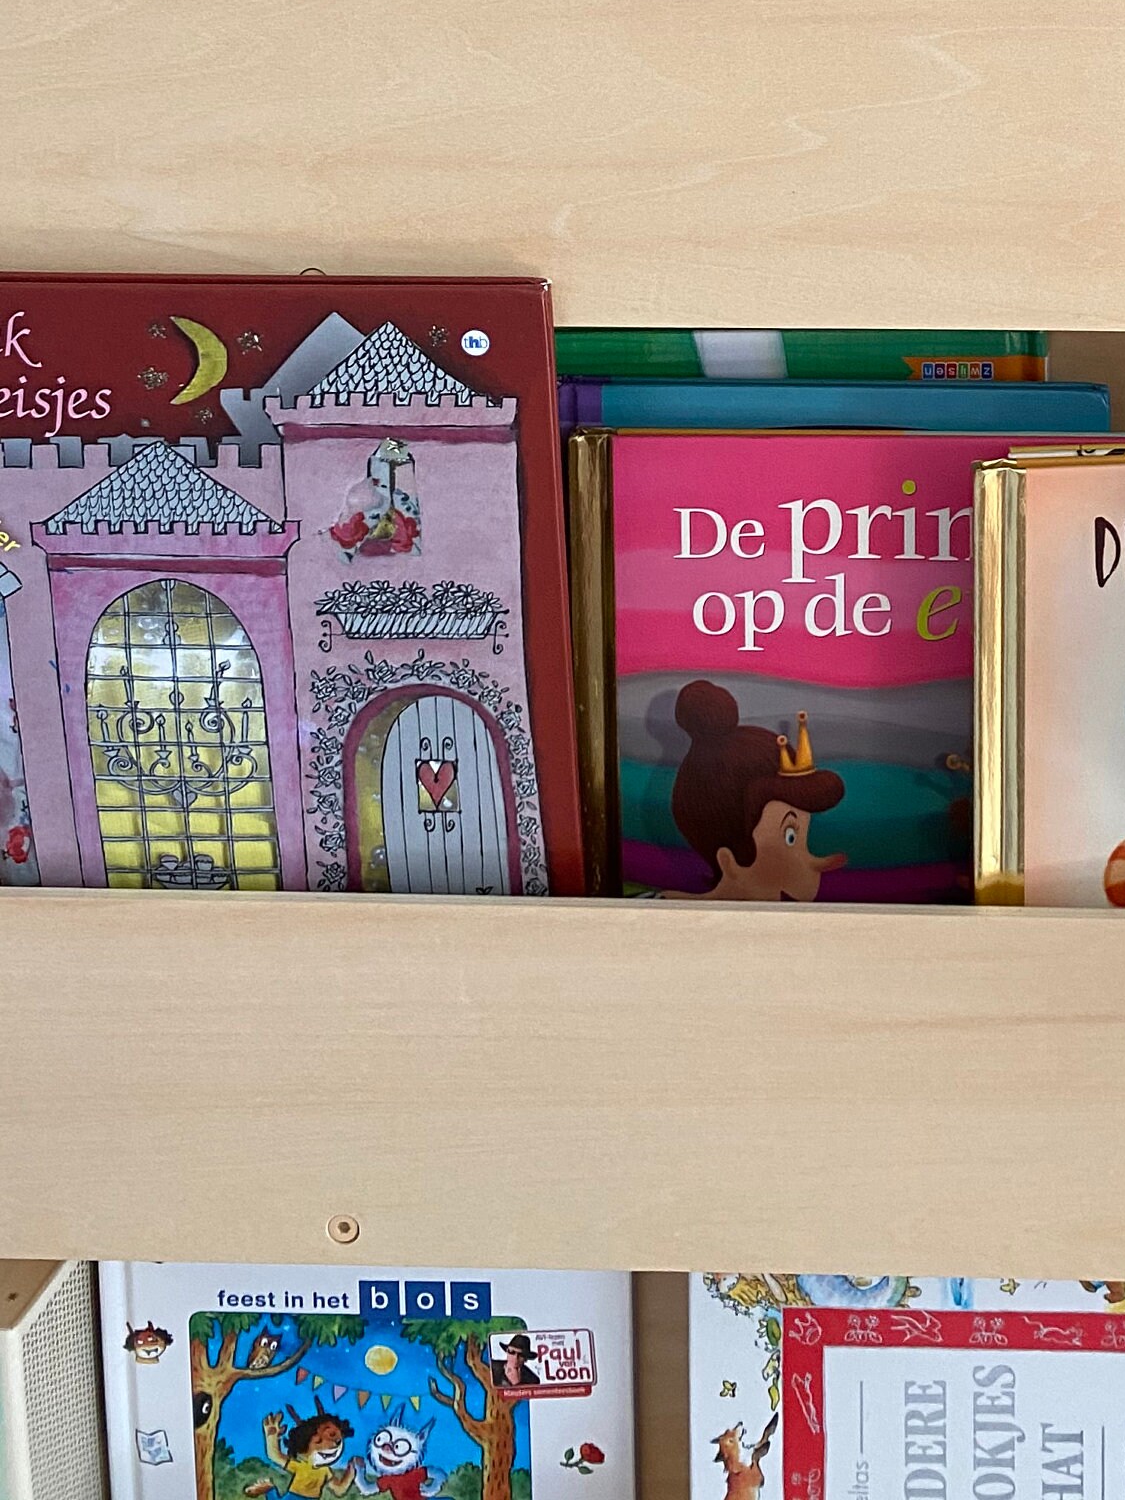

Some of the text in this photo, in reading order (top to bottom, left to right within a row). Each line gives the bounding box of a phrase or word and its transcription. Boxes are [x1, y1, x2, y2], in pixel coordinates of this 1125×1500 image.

[0, 311, 43, 368] k
[672, 479, 974, 584] De prin
[692, 589, 786, 651] op
[804, 572, 893, 637] de
[217, 1290, 276, 1308] feest
[284, 1290, 304, 1309] in
[313, 1291, 350, 1309] het
[536, 1338, 581, 1363] Paul
[544, 1359, 591, 1381] Loon
